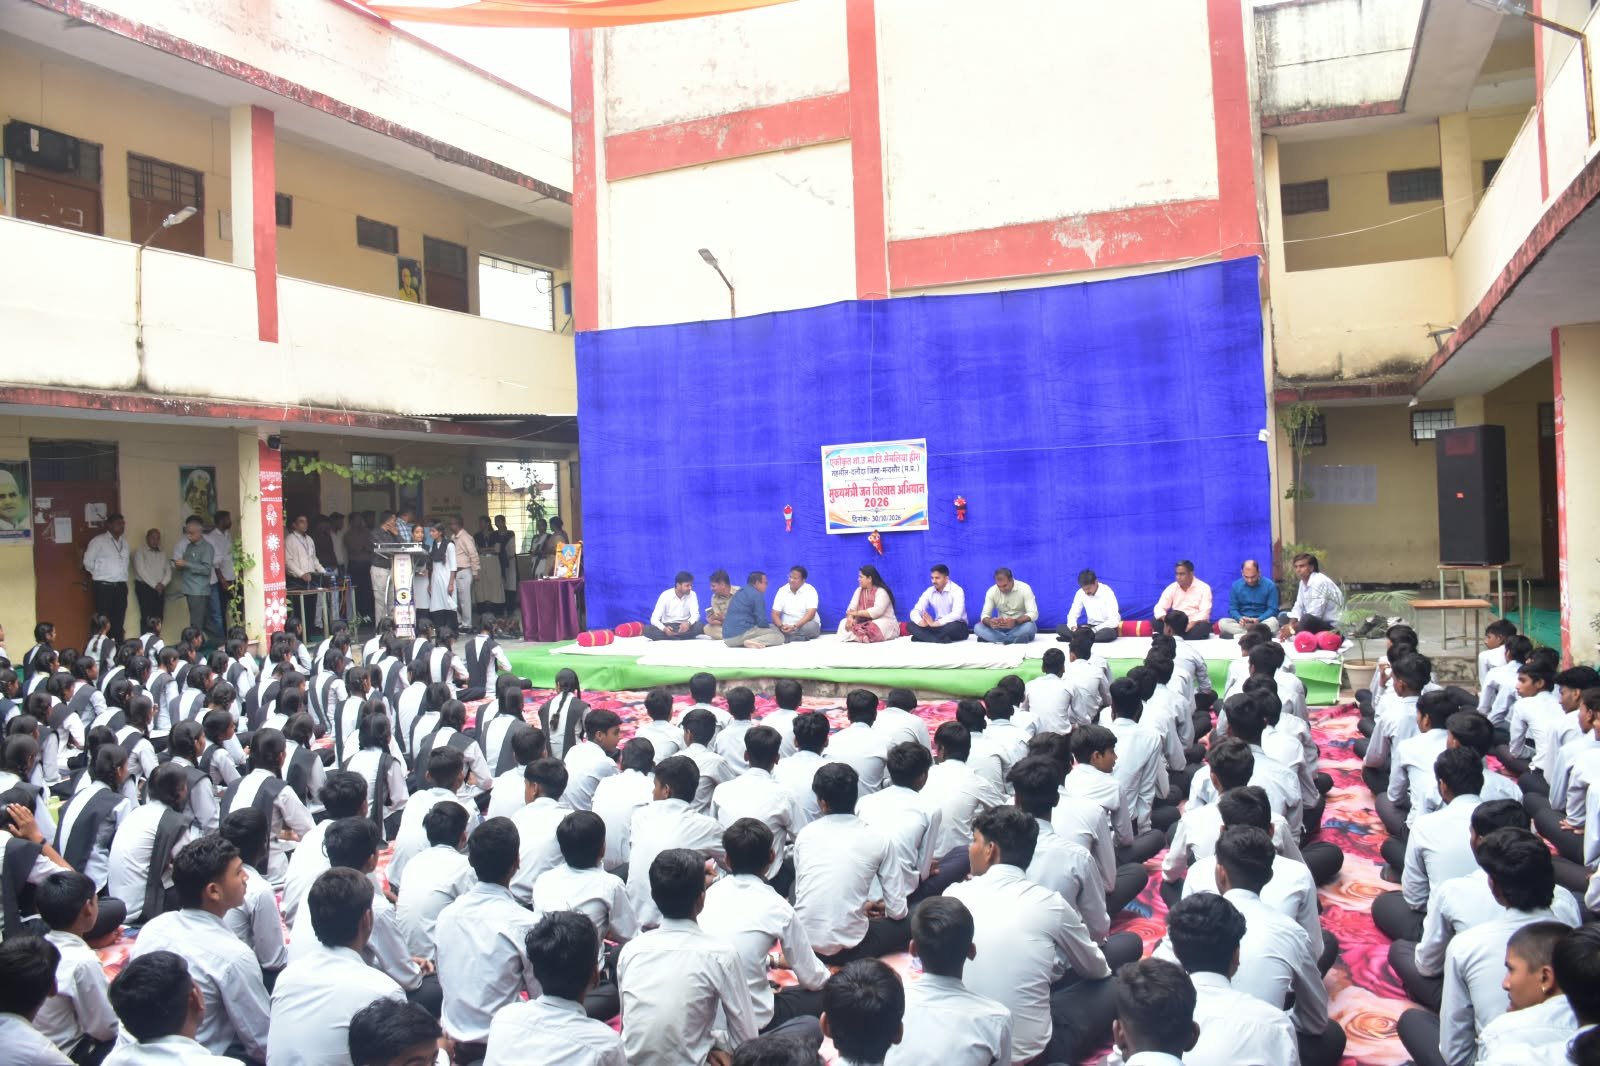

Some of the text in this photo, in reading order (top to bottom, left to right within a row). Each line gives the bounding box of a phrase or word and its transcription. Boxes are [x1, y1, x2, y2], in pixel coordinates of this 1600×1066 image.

[829, 480, 925, 504] मुख्यमंत्री जन विश्वास अभियान
[864, 497, 889, 508] 2026
